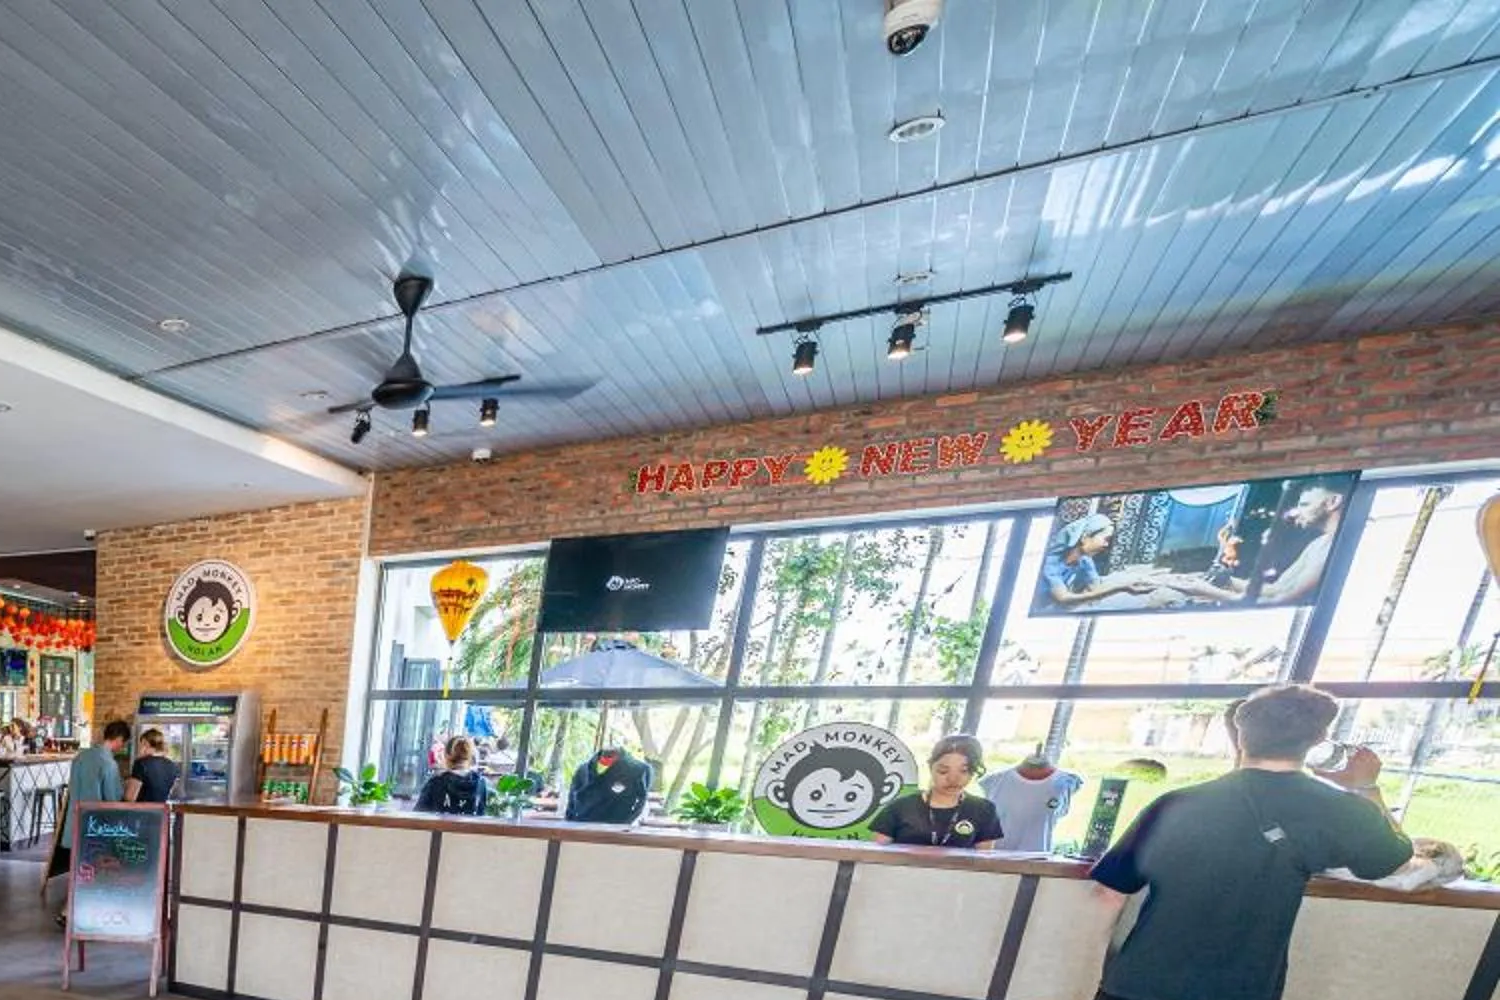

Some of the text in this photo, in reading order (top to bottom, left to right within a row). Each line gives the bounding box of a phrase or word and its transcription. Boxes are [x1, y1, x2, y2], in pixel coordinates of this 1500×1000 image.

[636, 391, 1267, 494] HAPPY NEW YEAR
[176, 568, 242, 601] MAD MONKEY
[770, 731, 905, 775] MAD MONKEY
